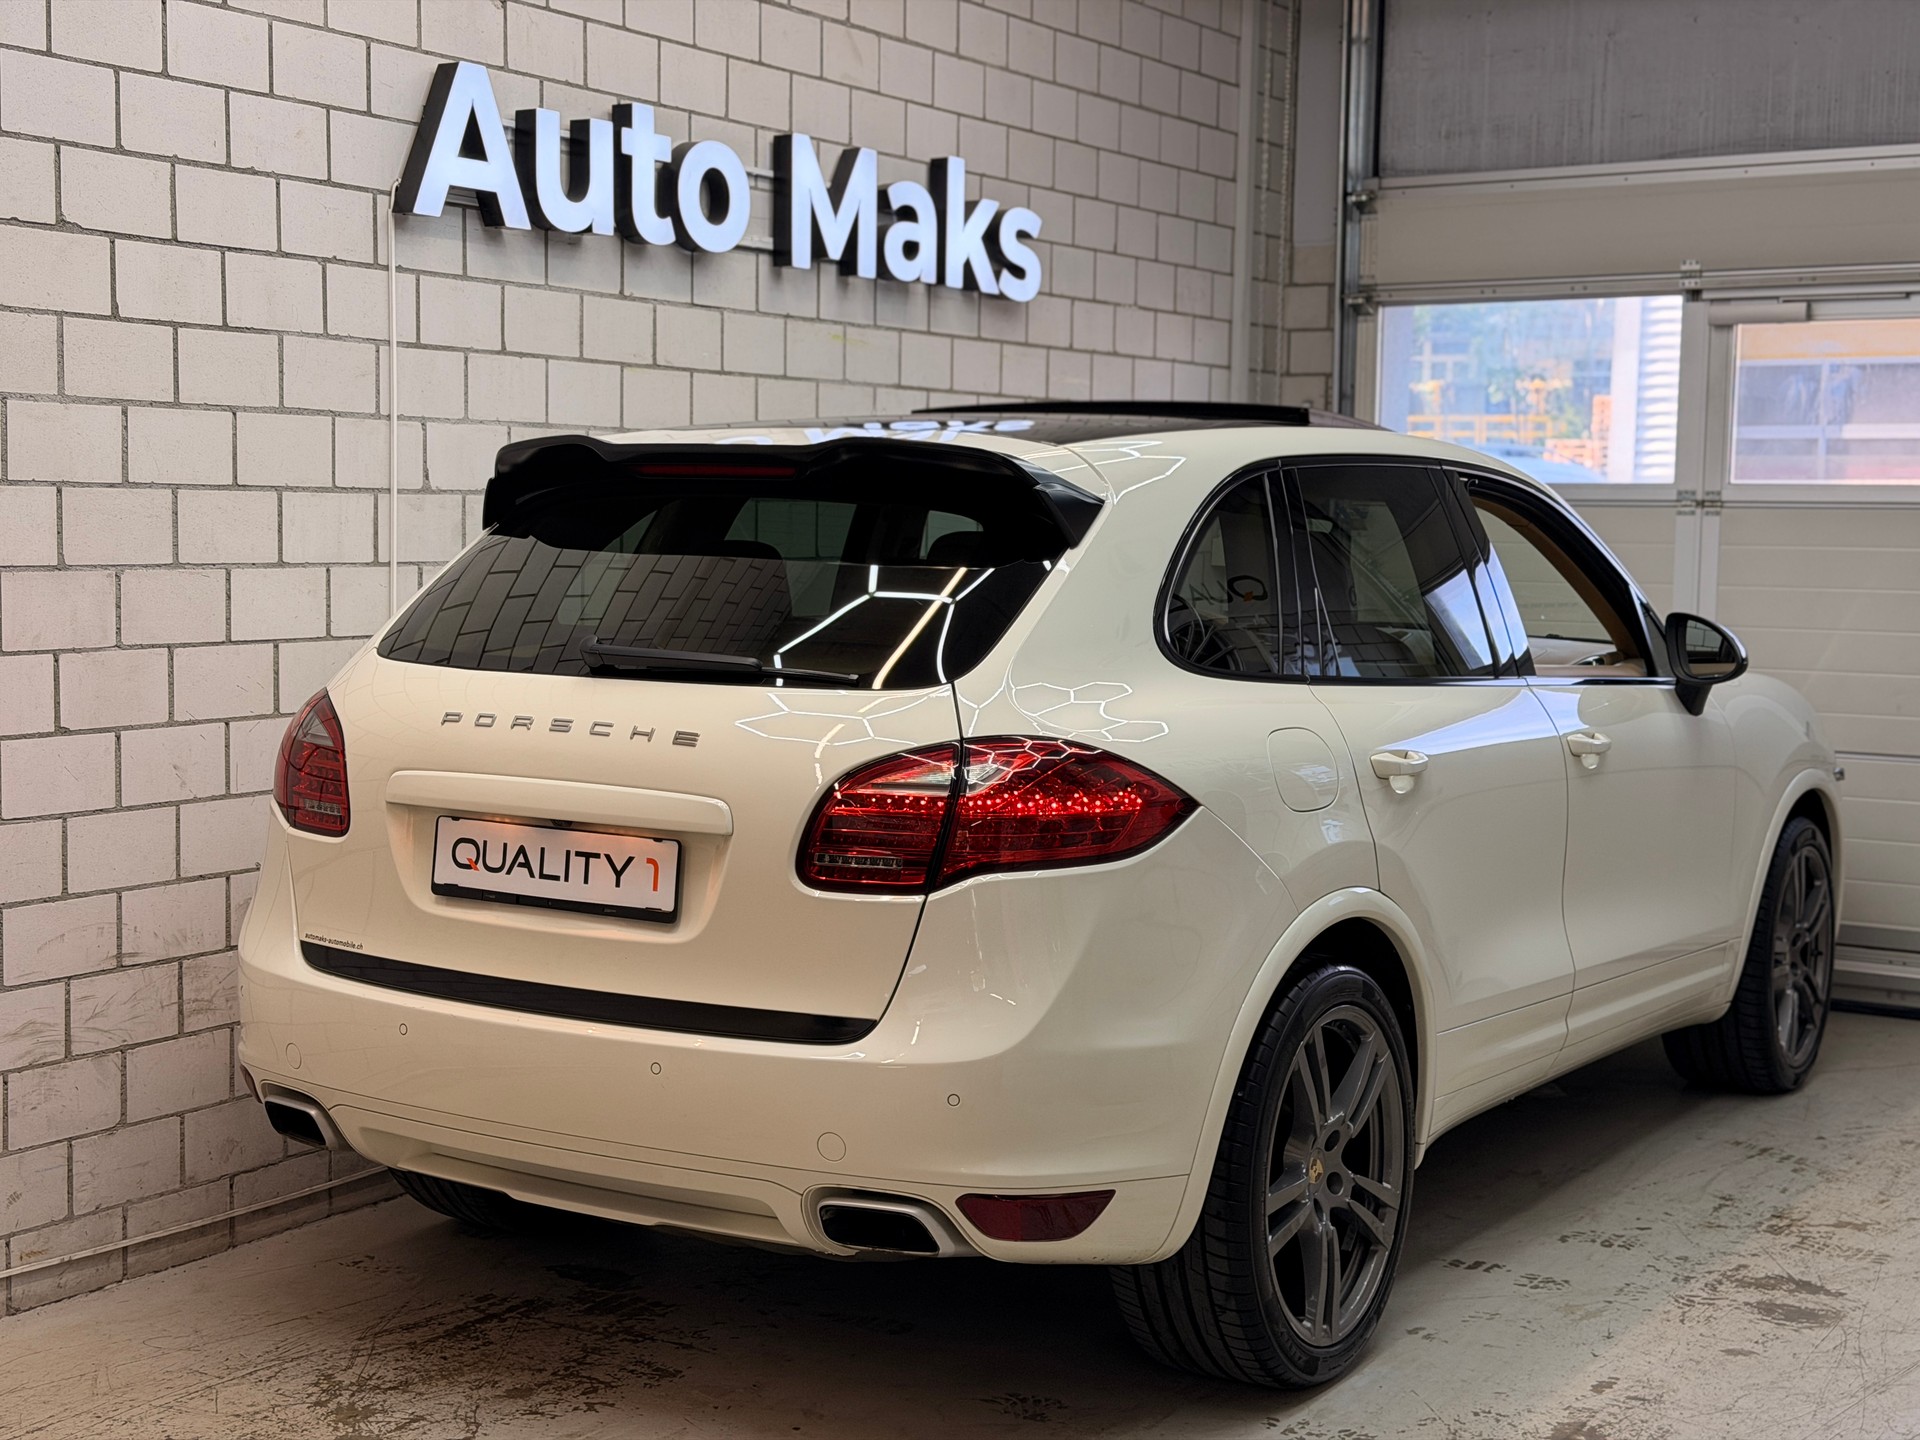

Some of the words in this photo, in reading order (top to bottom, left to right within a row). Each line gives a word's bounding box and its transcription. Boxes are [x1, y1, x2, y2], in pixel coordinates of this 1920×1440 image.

[412, 60, 751, 253] Auto
[790, 132, 1043, 302] Maks
[441, 711, 701, 748] PORSCHE
[304, 932, 363, 950] automaks-automobile.ch
